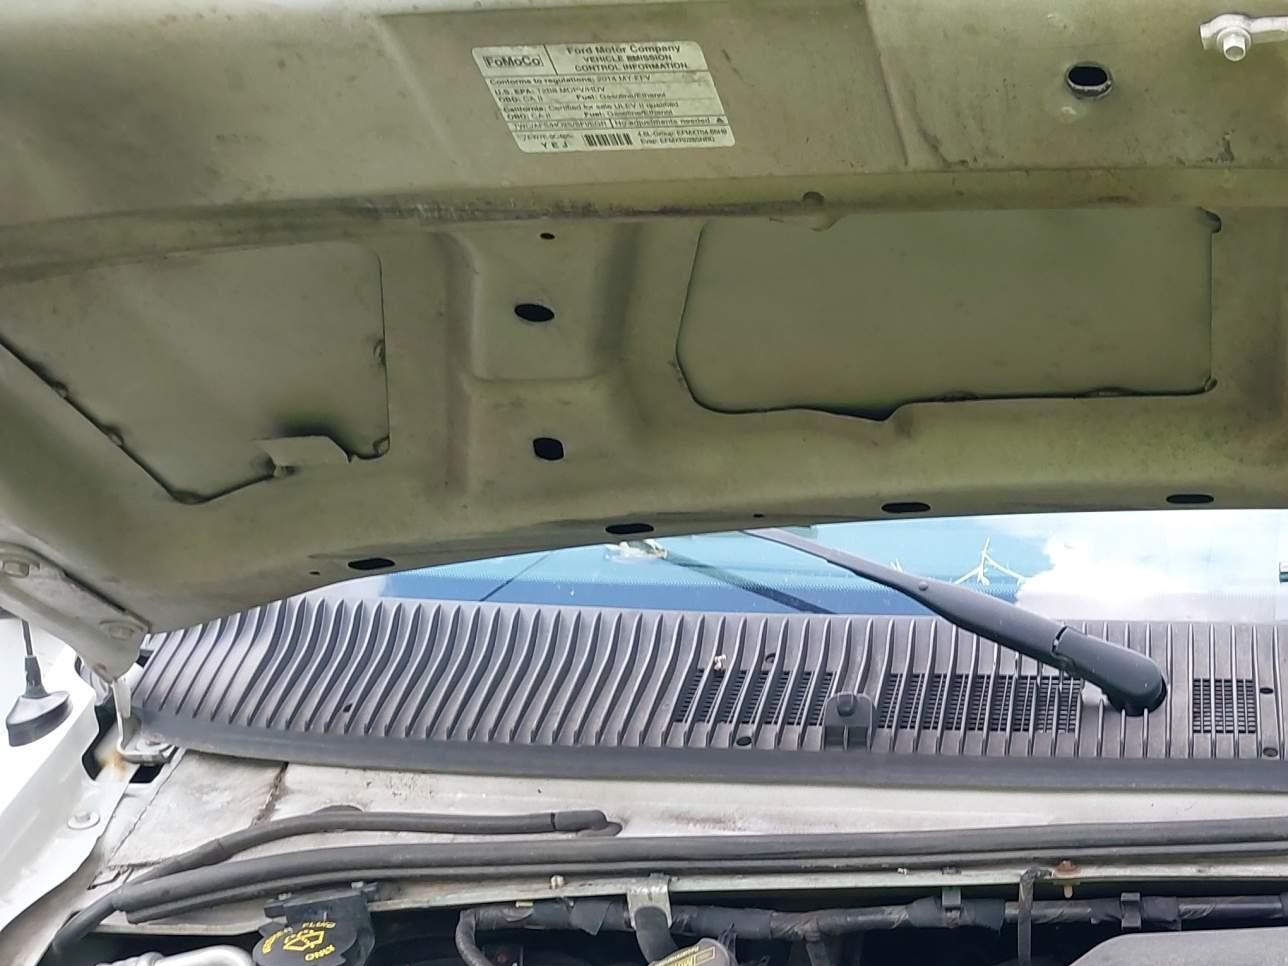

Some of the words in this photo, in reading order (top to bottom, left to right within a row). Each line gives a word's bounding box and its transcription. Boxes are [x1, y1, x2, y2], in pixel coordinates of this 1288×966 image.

[565, 46, 593, 55] Ford
[594, 45, 627, 54] Motor
[628, 43, 682, 54] Company
[482, 54, 543, 67] FoMoCo
[621, 62, 688, 70] INFORMATION
[488, 77, 532, 85] Conforms
